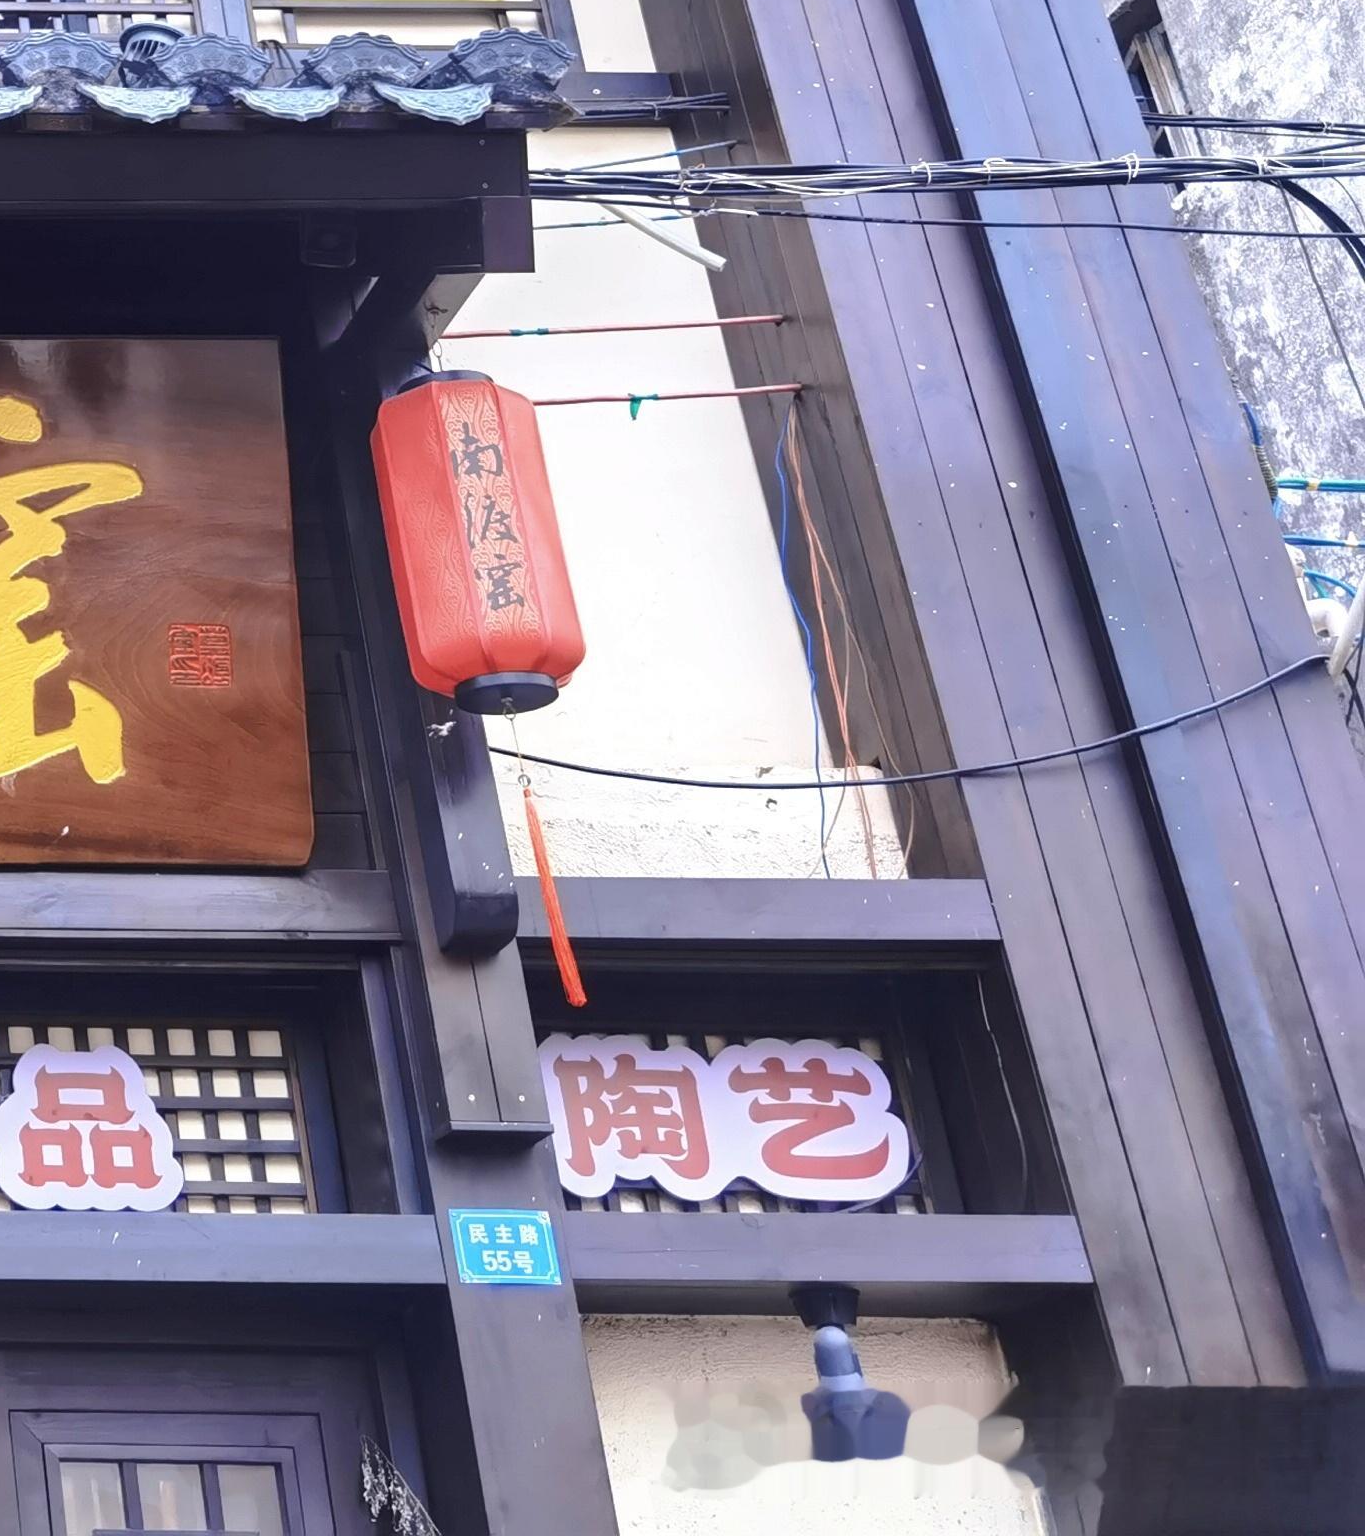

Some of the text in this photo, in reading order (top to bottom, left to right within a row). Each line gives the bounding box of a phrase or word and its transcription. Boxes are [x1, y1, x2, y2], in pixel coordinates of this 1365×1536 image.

[450, 421, 524, 613] 南渡窑
[552, 1052, 890, 1182] 陶艺
[467, 1222, 540, 1246] 民主路
[481, 1249, 535, 1275] 55号
